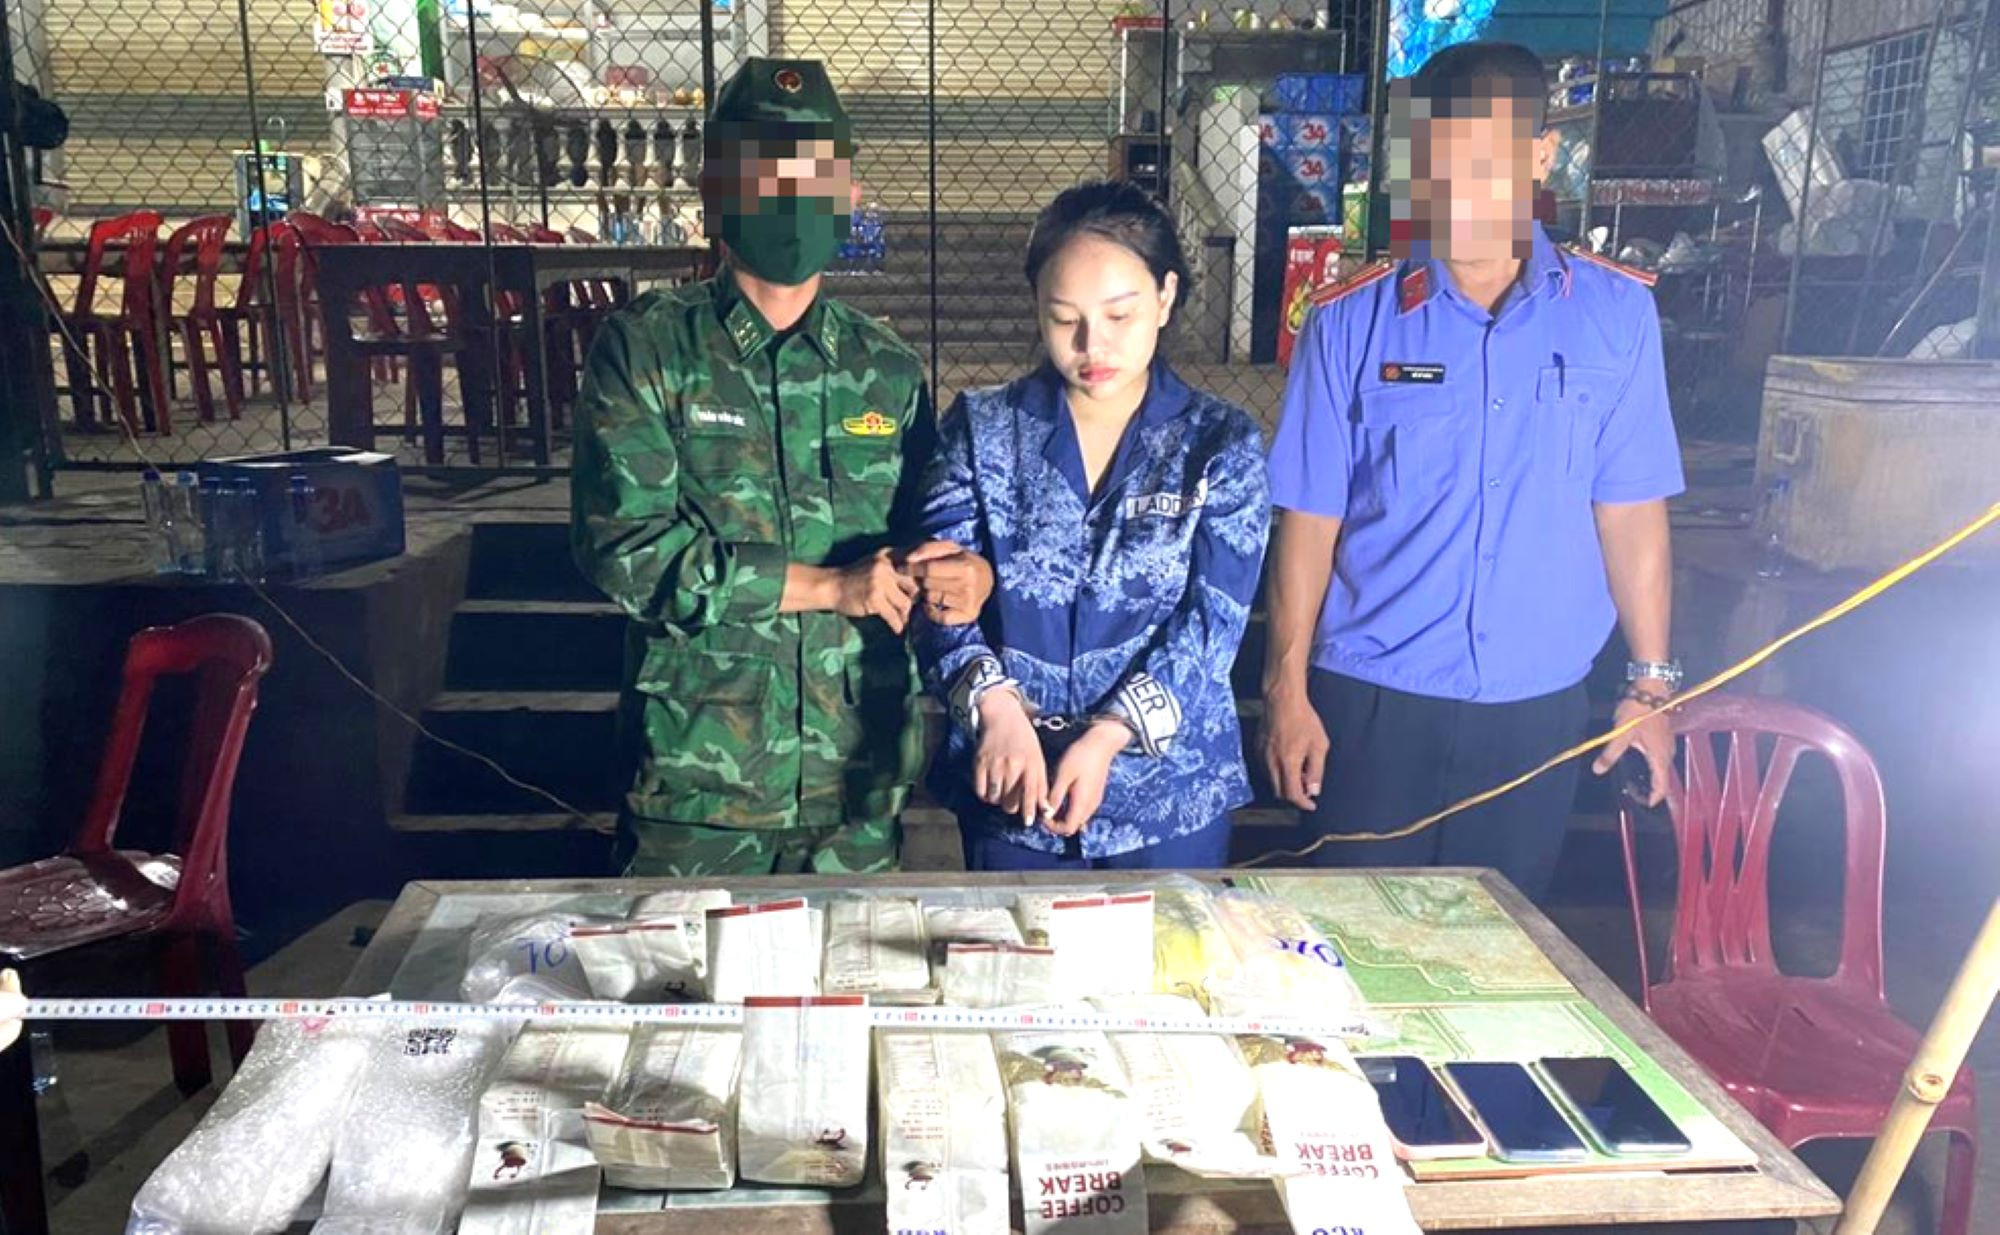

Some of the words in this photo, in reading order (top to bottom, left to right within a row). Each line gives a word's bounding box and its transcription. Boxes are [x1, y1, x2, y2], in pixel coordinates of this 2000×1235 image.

[1294, 1142, 1374, 1161] BREAK
[1038, 1171, 1122, 1195] BREAK
[1039, 1195, 1125, 1219] COFFEE
